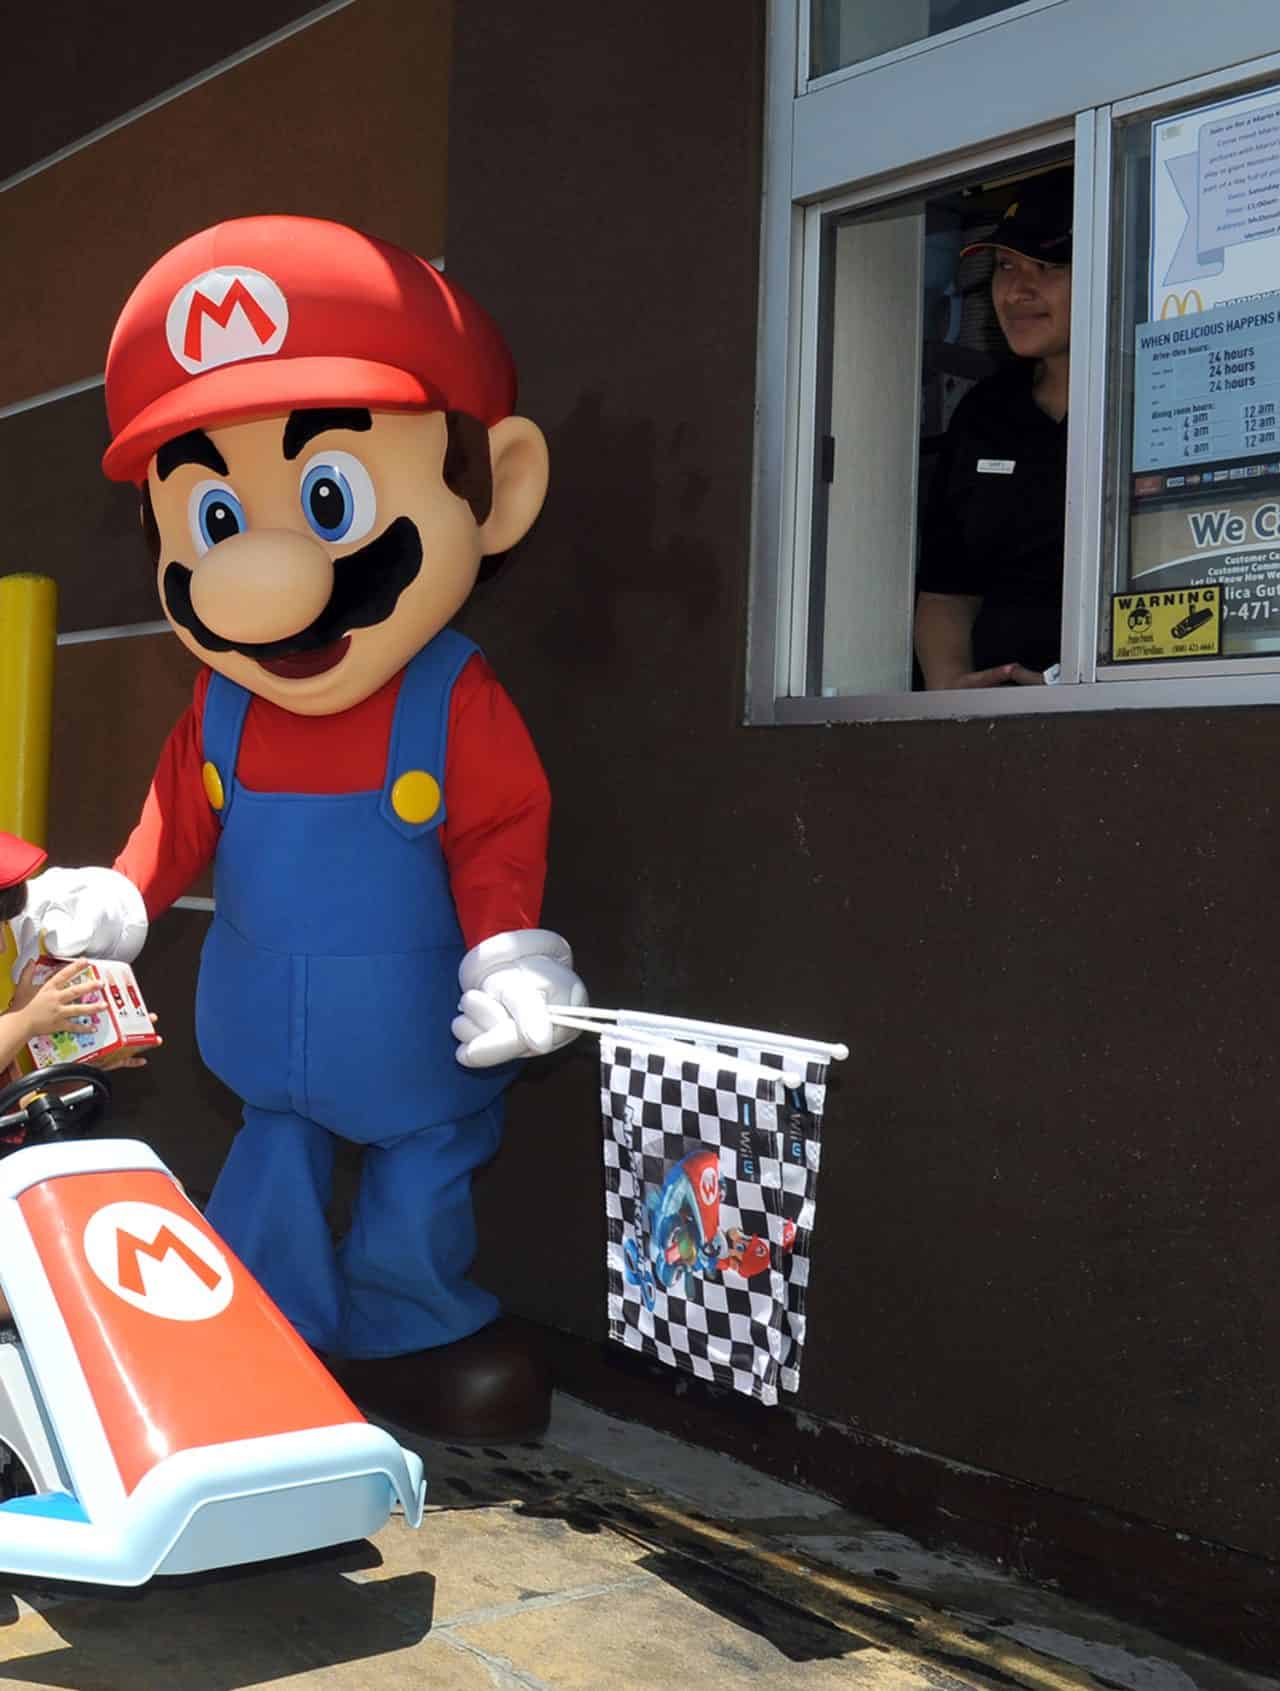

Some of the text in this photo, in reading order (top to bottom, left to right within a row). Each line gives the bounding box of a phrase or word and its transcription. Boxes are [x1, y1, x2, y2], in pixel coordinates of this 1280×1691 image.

[183, 278, 277, 362] M
[1140, 333, 1170, 349] WHEN
[1172, 322, 1224, 344] DELICIOUS
[1226, 312, 1275, 333] HAPPENS
[1208, 347, 1255, 364] 24 hours
[1209, 361, 1256, 377] 24 hours
[1209, 376, 1256, 392] 24 hours
[1192, 413, 1208, 424] am
[1244, 406, 1257, 418] 12
[1258, 403, 1275, 414] am
[1193, 426, 1209, 437] am
[1245, 420, 1257, 432] 12
[1259, 416, 1276, 427] am
[1193, 442, 1209, 453] am
[1245, 435, 1257, 448] 12
[1259, 431, 1275, 442] am
[1188, 504, 1280, 548] We C
[1118, 590, 1215, 610] WARNING
[1225, 586, 1251, 600] lica
[116, 1224, 222, 1297] M
